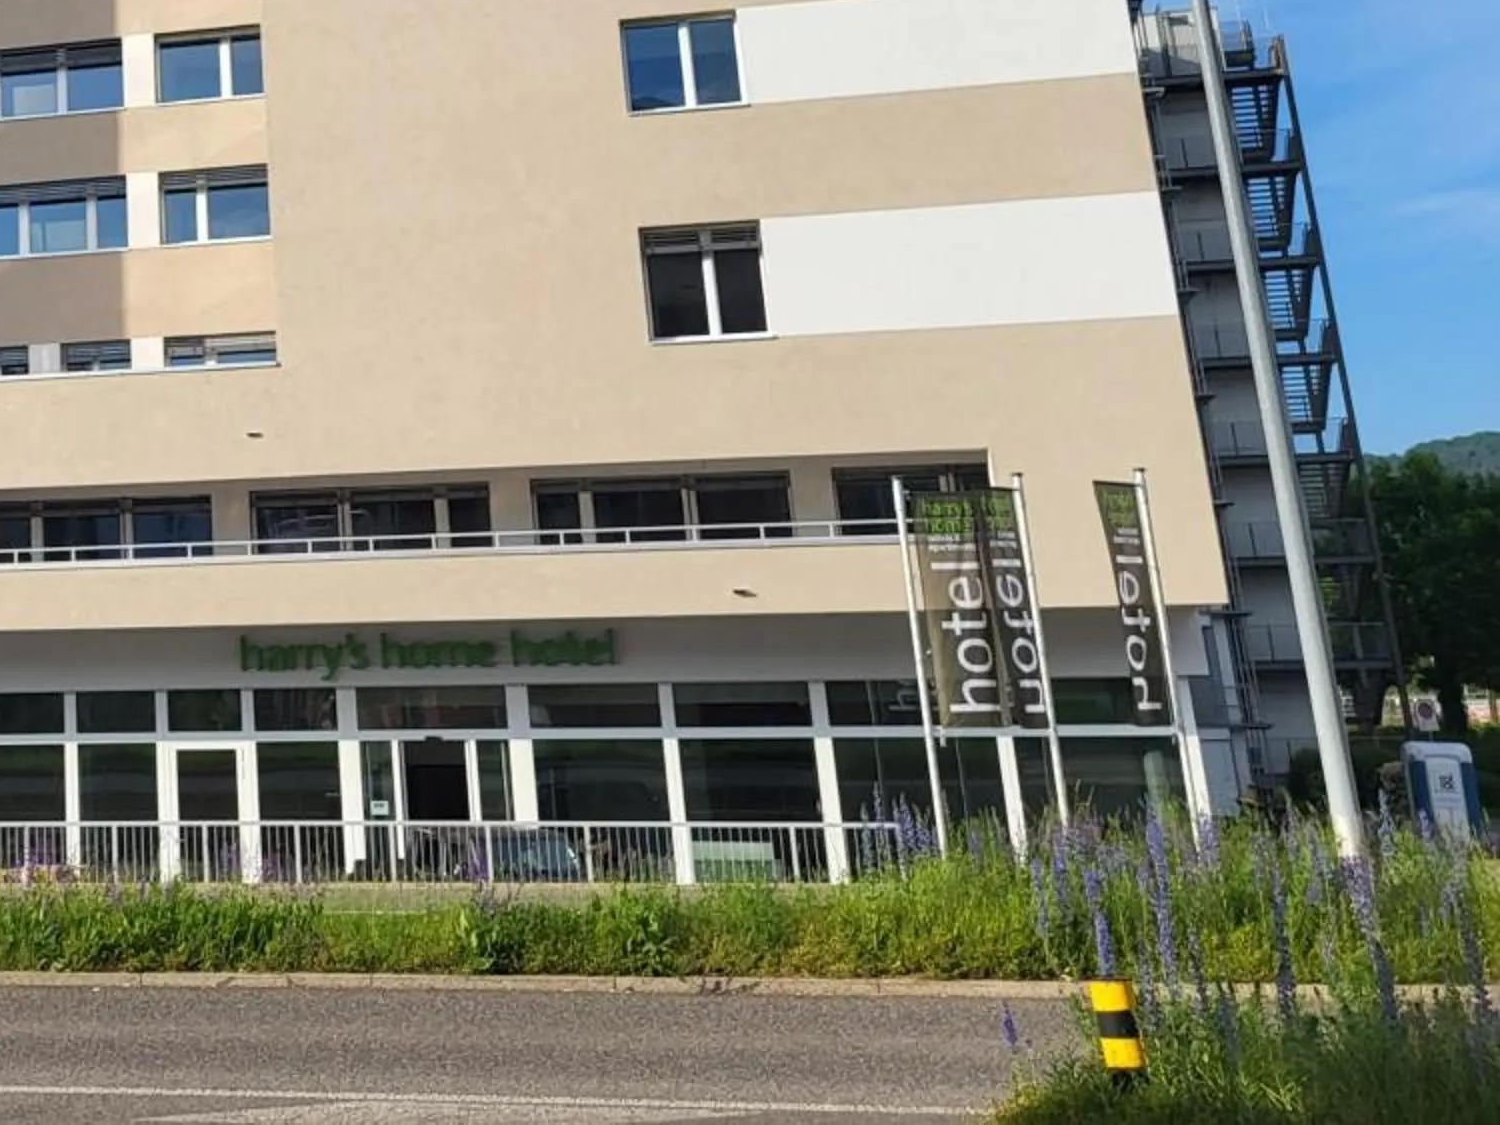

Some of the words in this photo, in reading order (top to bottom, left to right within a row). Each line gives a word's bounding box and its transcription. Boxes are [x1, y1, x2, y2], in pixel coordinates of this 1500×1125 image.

[239, 632, 369, 681] harry's
[379, 632, 497, 669] home
[509, 628, 617, 666] hotel
[930, 560, 1001, 715] hotel
